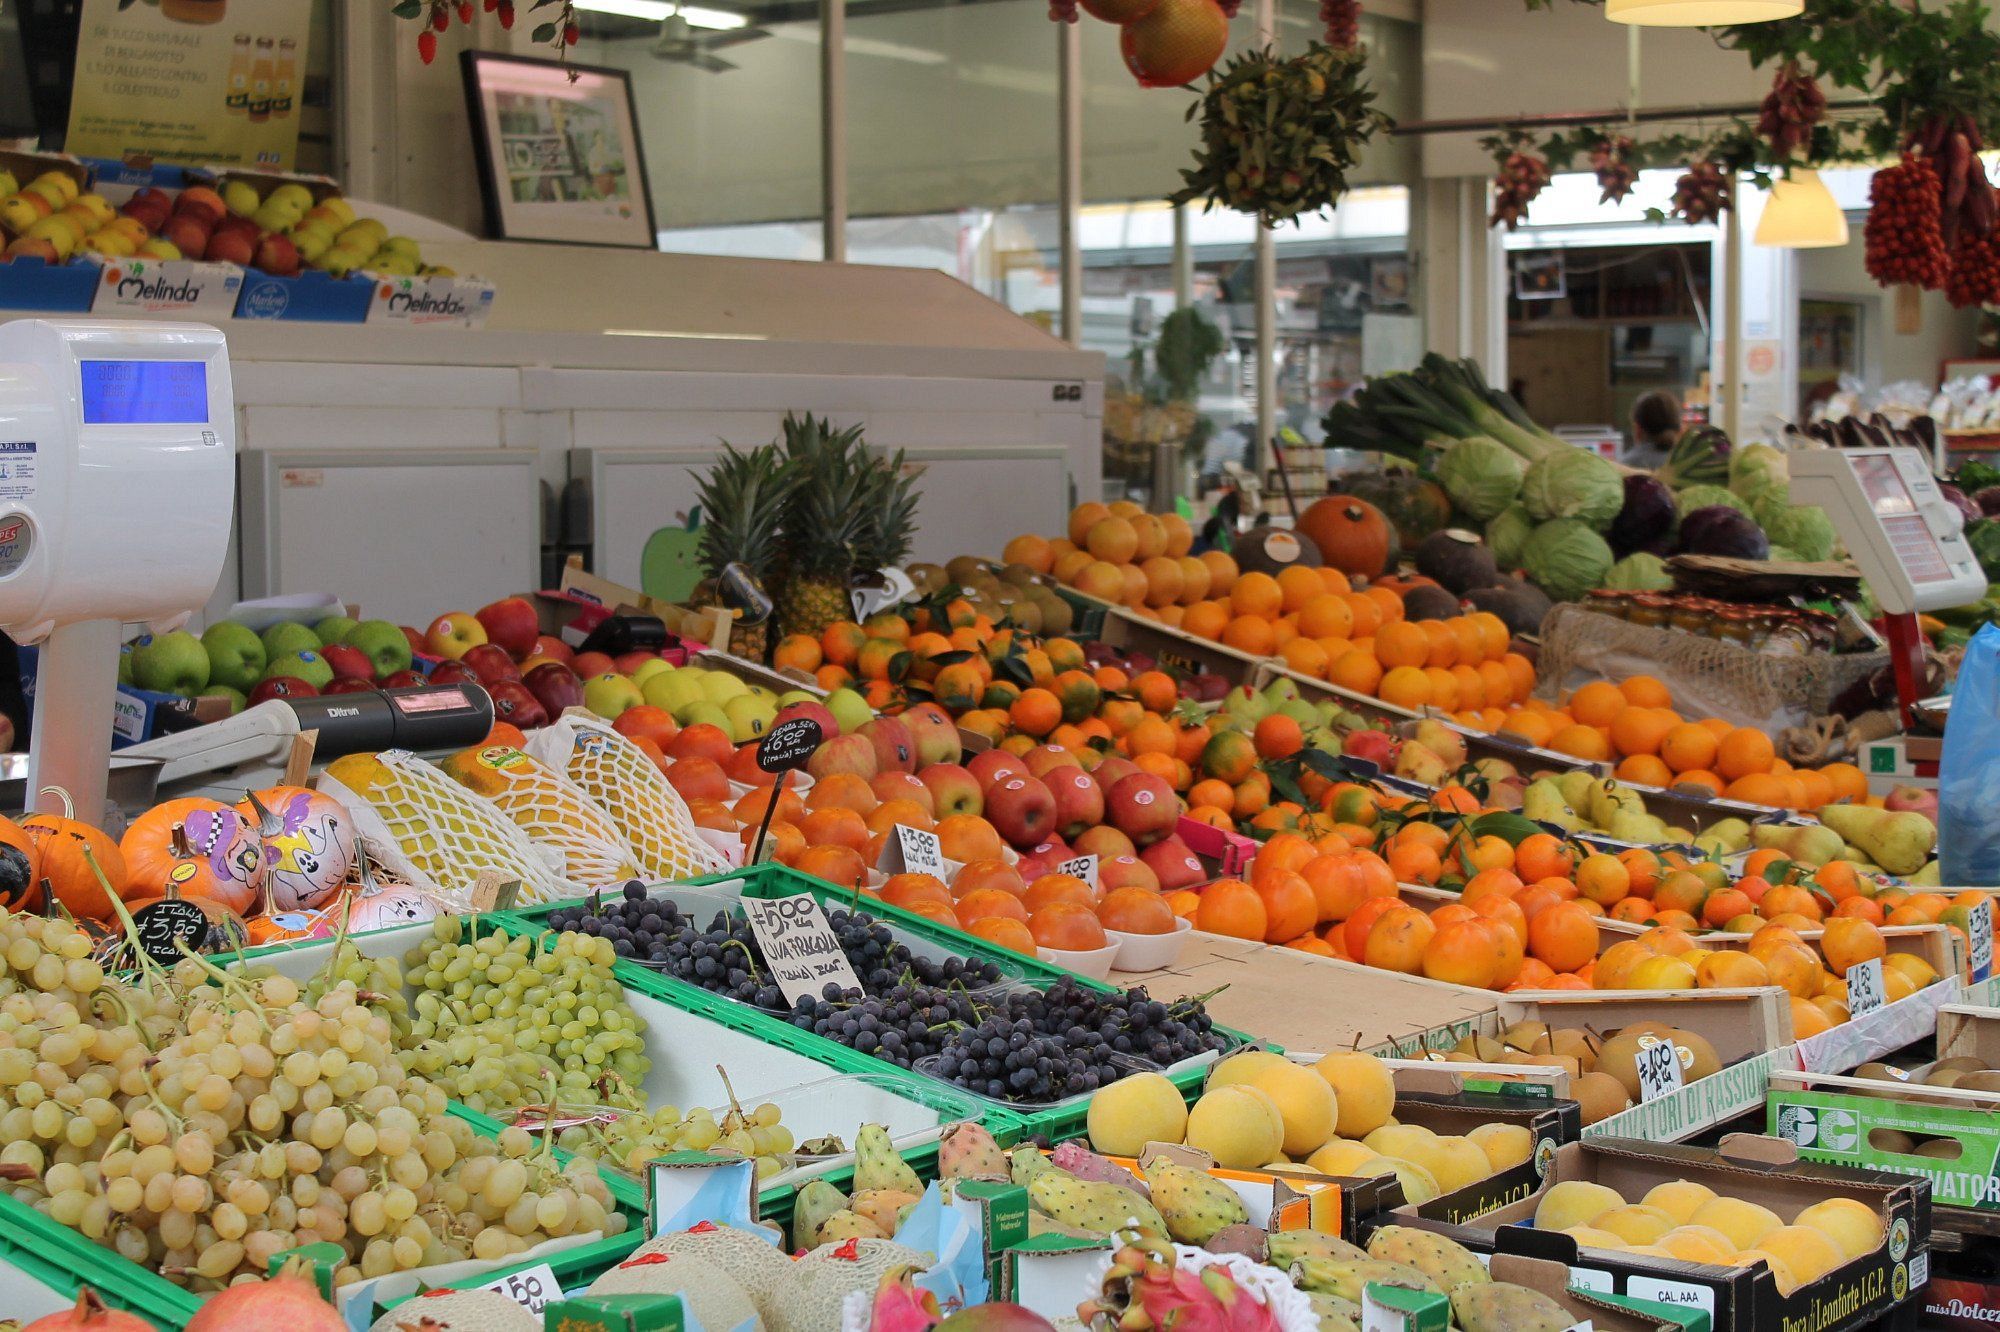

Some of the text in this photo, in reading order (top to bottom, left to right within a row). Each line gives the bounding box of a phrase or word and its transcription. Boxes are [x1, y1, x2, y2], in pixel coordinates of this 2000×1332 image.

[118, 277, 200, 303] Melinda
[389, 292, 460, 314] Melinda
[327, 707, 360, 718] Ditron
[1658, 1291, 1699, 1303] CAL. AAA
[1816, 1283, 1860, 1332] Leonforte
[1861, 1267, 1886, 1305] I.G.P.
